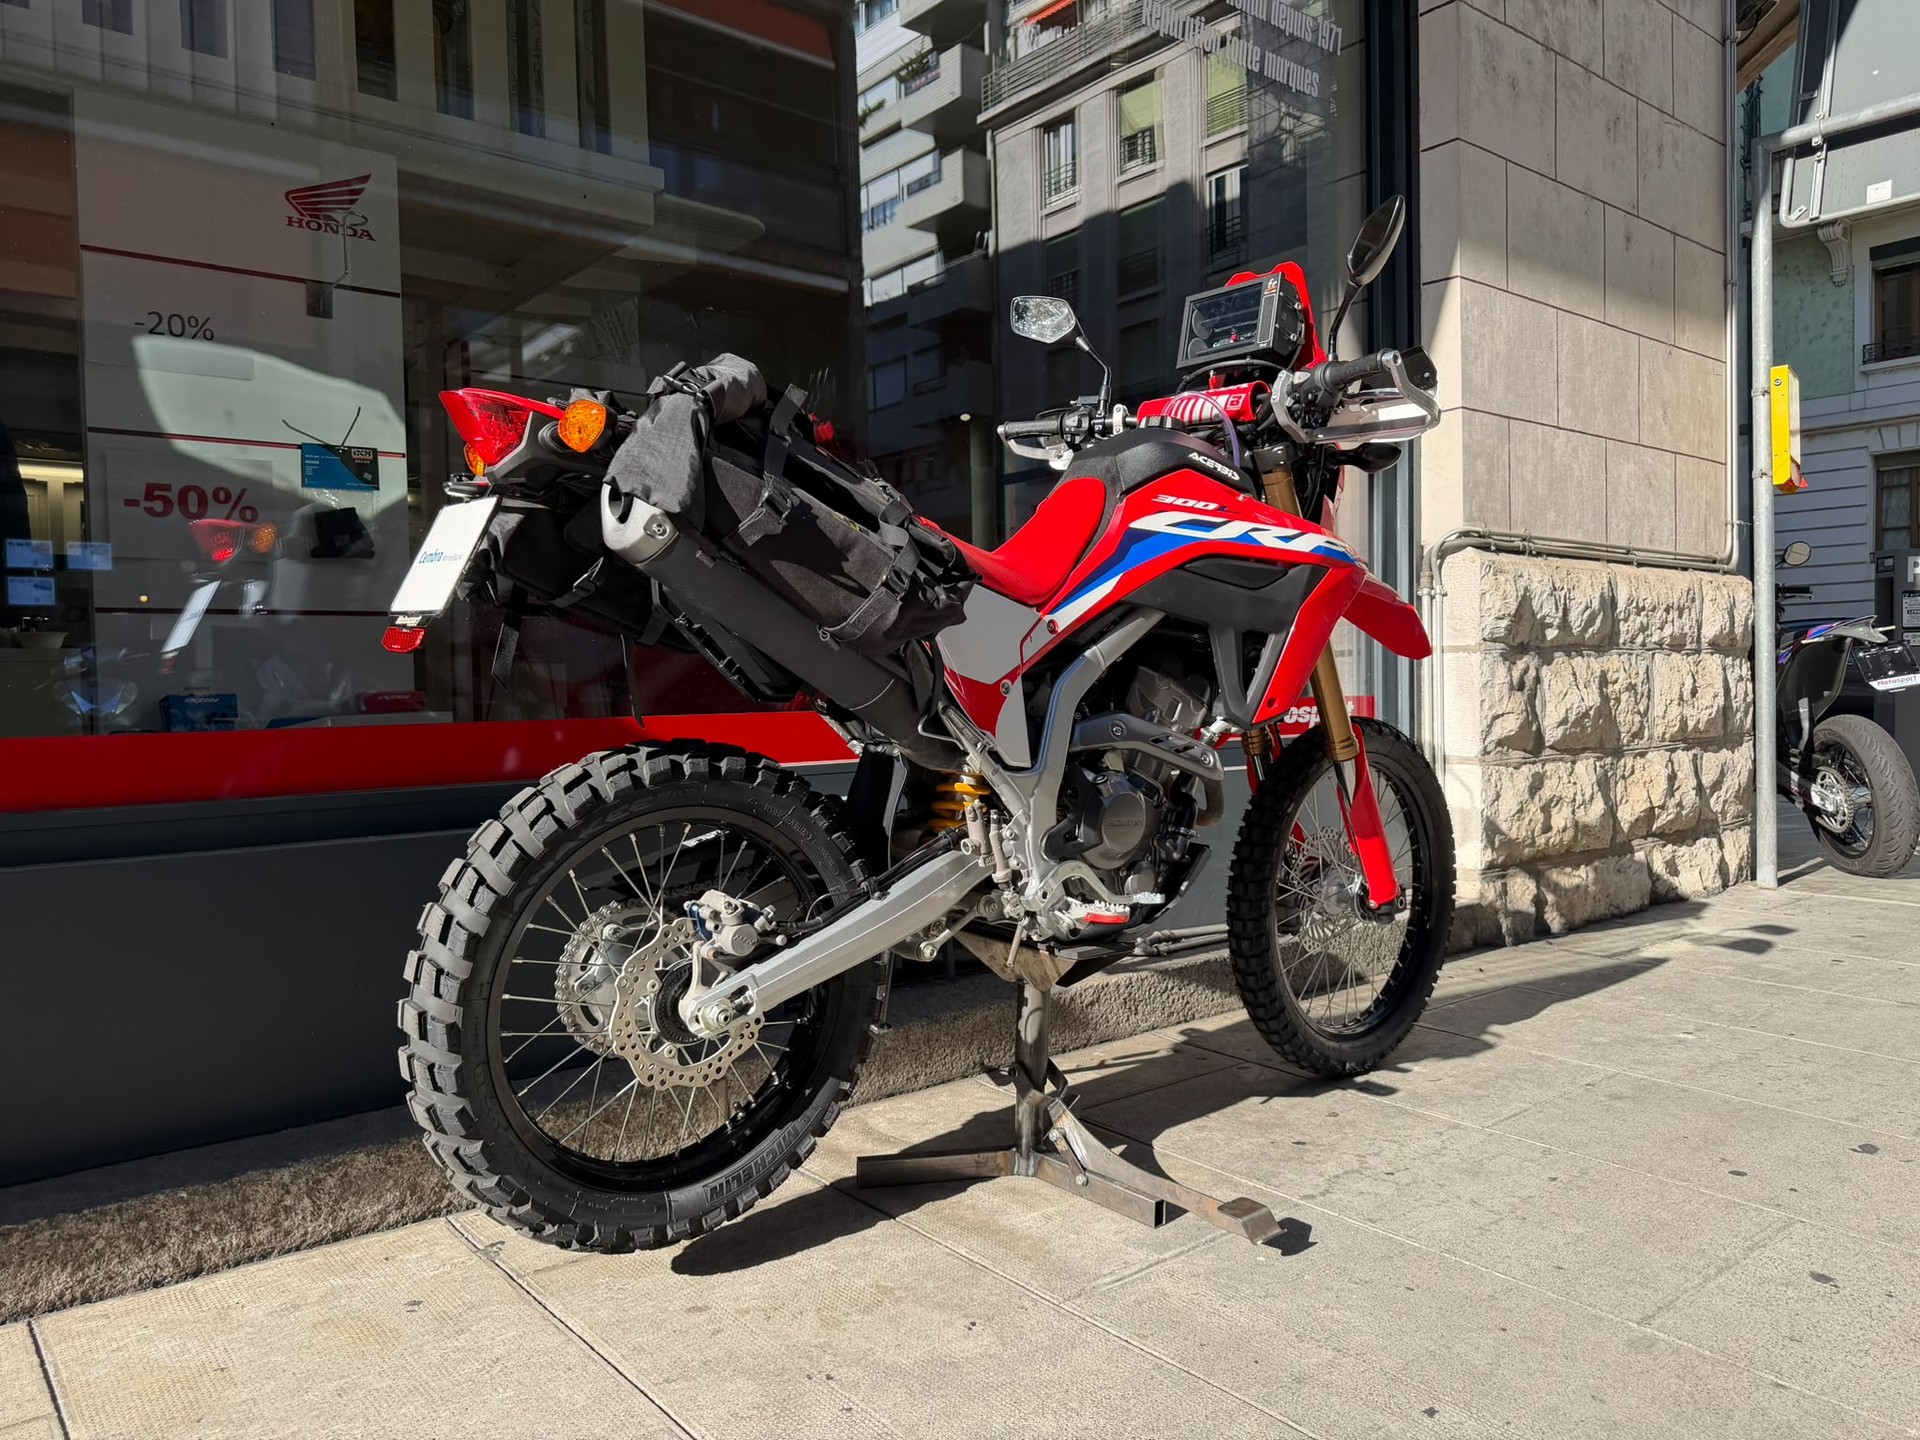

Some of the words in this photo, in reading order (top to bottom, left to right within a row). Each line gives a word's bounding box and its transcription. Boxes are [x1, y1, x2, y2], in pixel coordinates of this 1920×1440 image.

[1269, 0, 1312, 42] depuis
[1317, 15, 1342, 56] 1971
[1226, 30, 1260, 73] toute
[1263, 50, 1320, 98] marques
[285, 215, 376, 241] HONDA
[134, 310, 215, 341] -20%
[1188, 451, 1240, 481] ACERBIS
[123, 482, 259, 524] -50%
[709, 1124, 802, 1199] MICHELIN
